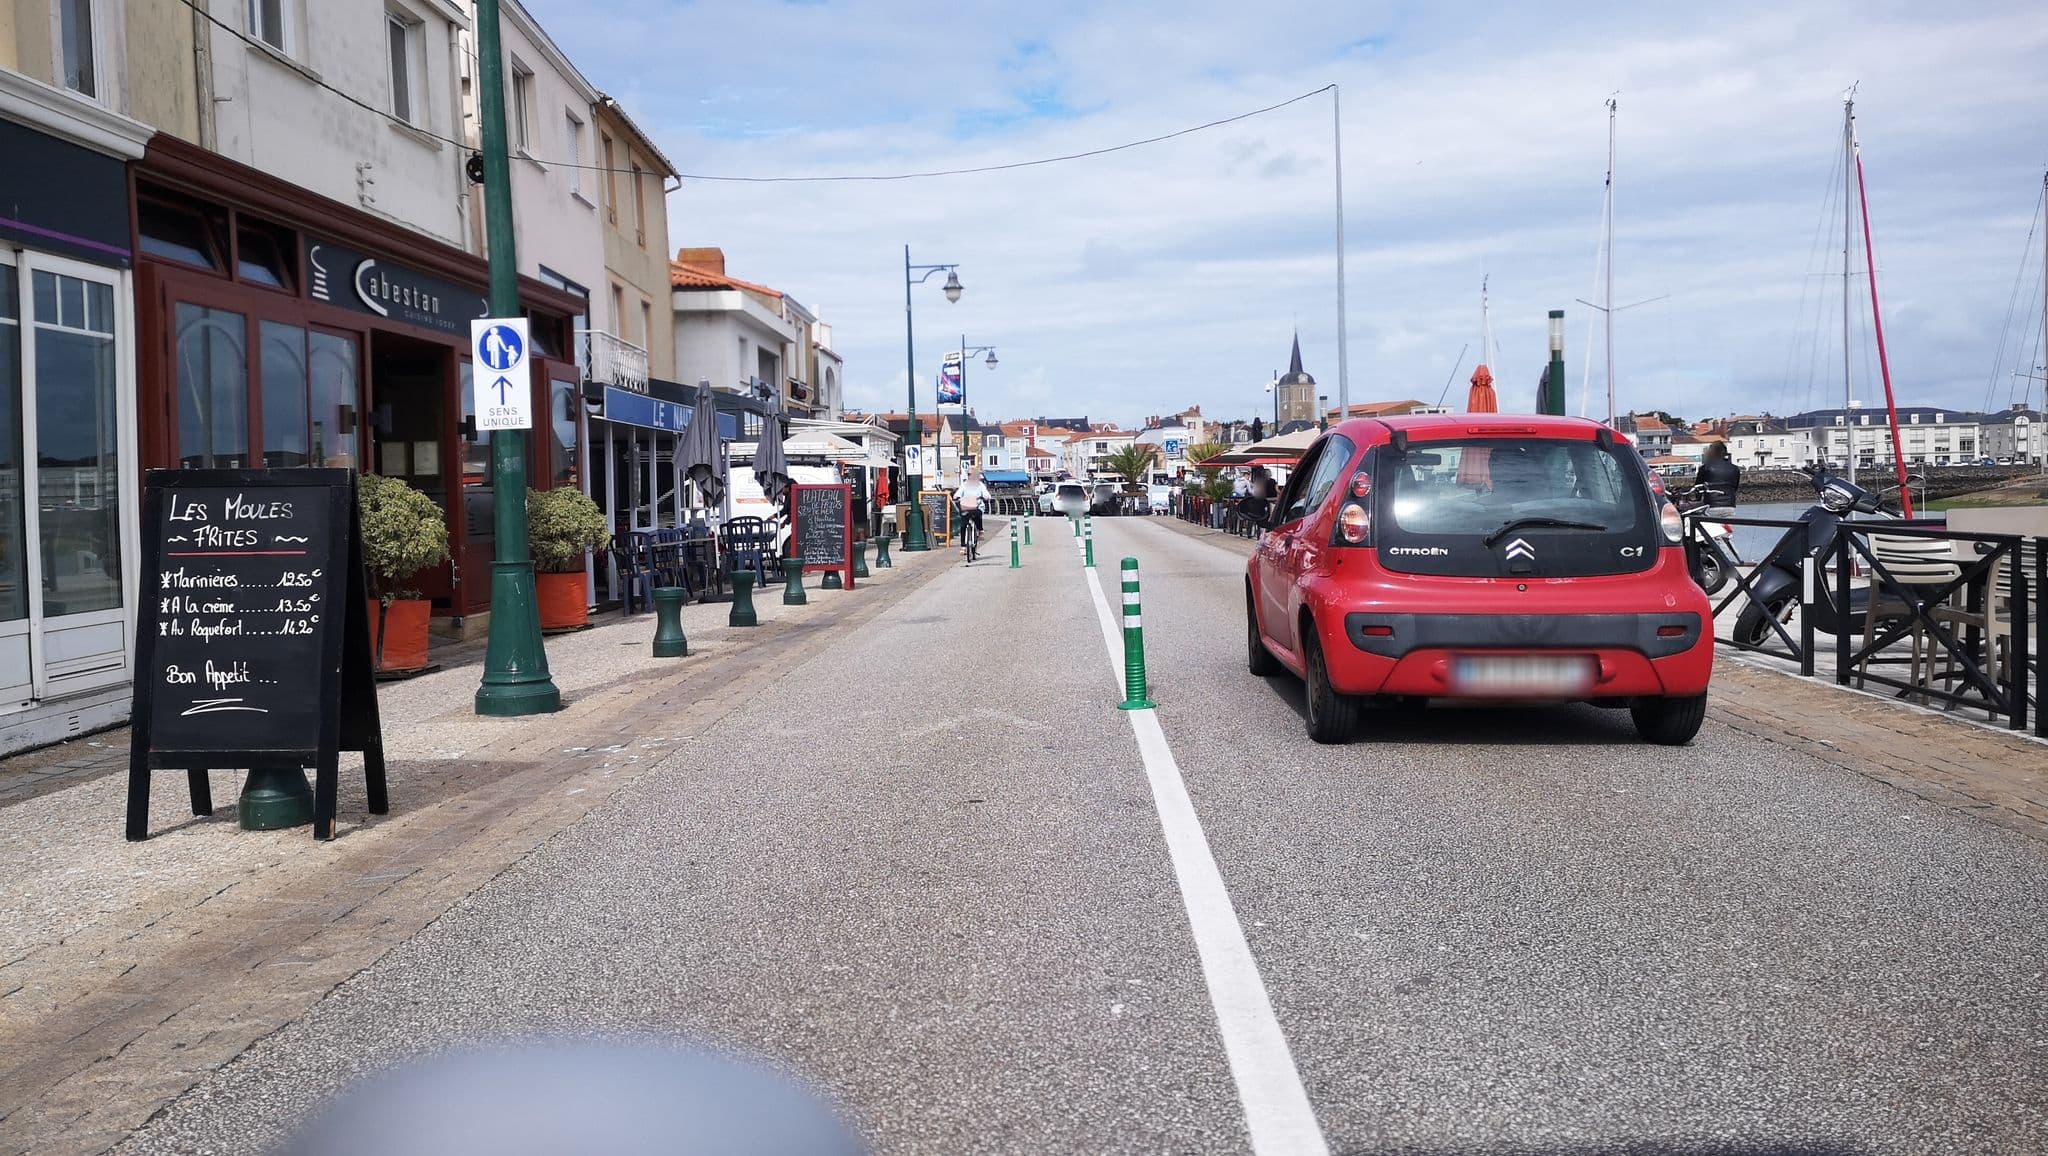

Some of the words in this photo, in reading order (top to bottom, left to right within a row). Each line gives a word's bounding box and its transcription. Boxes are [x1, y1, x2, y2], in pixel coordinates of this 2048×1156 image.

[355, 258, 440, 317] Cabestan
[482, 417, 525, 427] UNIQUE
[488, 407, 518, 416] SENS
[653, 401, 665, 427] LE
[673, 406, 694, 430] NAUT
[802, 489, 840, 503] PLATEAU
[169, 494, 208, 521] LES
[225, 493, 294, 521] MOULES
[1620, 546, 1644, 557] C1
[171, 597, 180, 614] A
[186, 596, 199, 614] la
[203, 597, 235, 614] crème
[191, 618, 242, 643] Roquefort
[166, 665, 196, 684] Bon
[206, 660, 250, 691] Appetit
